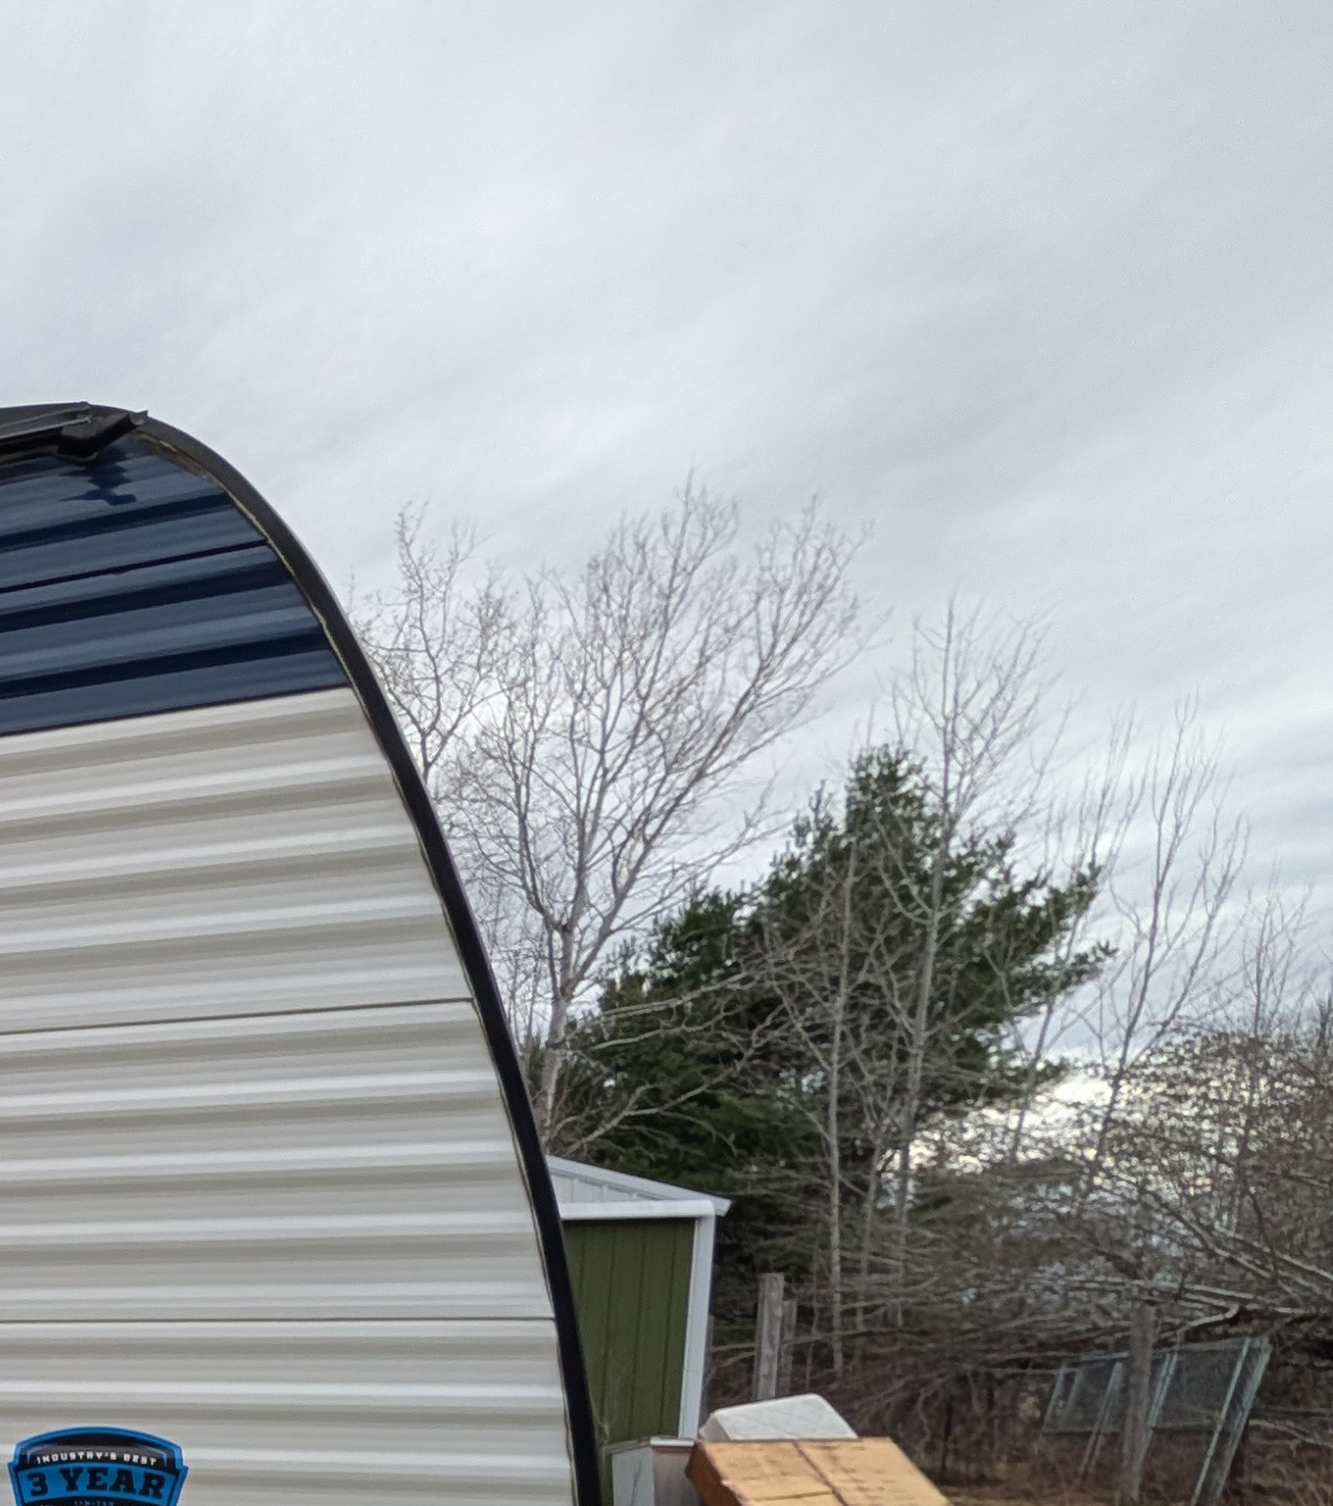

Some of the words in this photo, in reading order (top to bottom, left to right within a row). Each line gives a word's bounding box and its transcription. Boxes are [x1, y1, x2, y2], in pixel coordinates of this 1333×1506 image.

[36, 1451, 117, 1465] INDUSTRY'S
[123, 1454, 158, 1466] BEST
[27, 1472, 48, 1497] 3
[59, 1467, 167, 1499] YEAR
